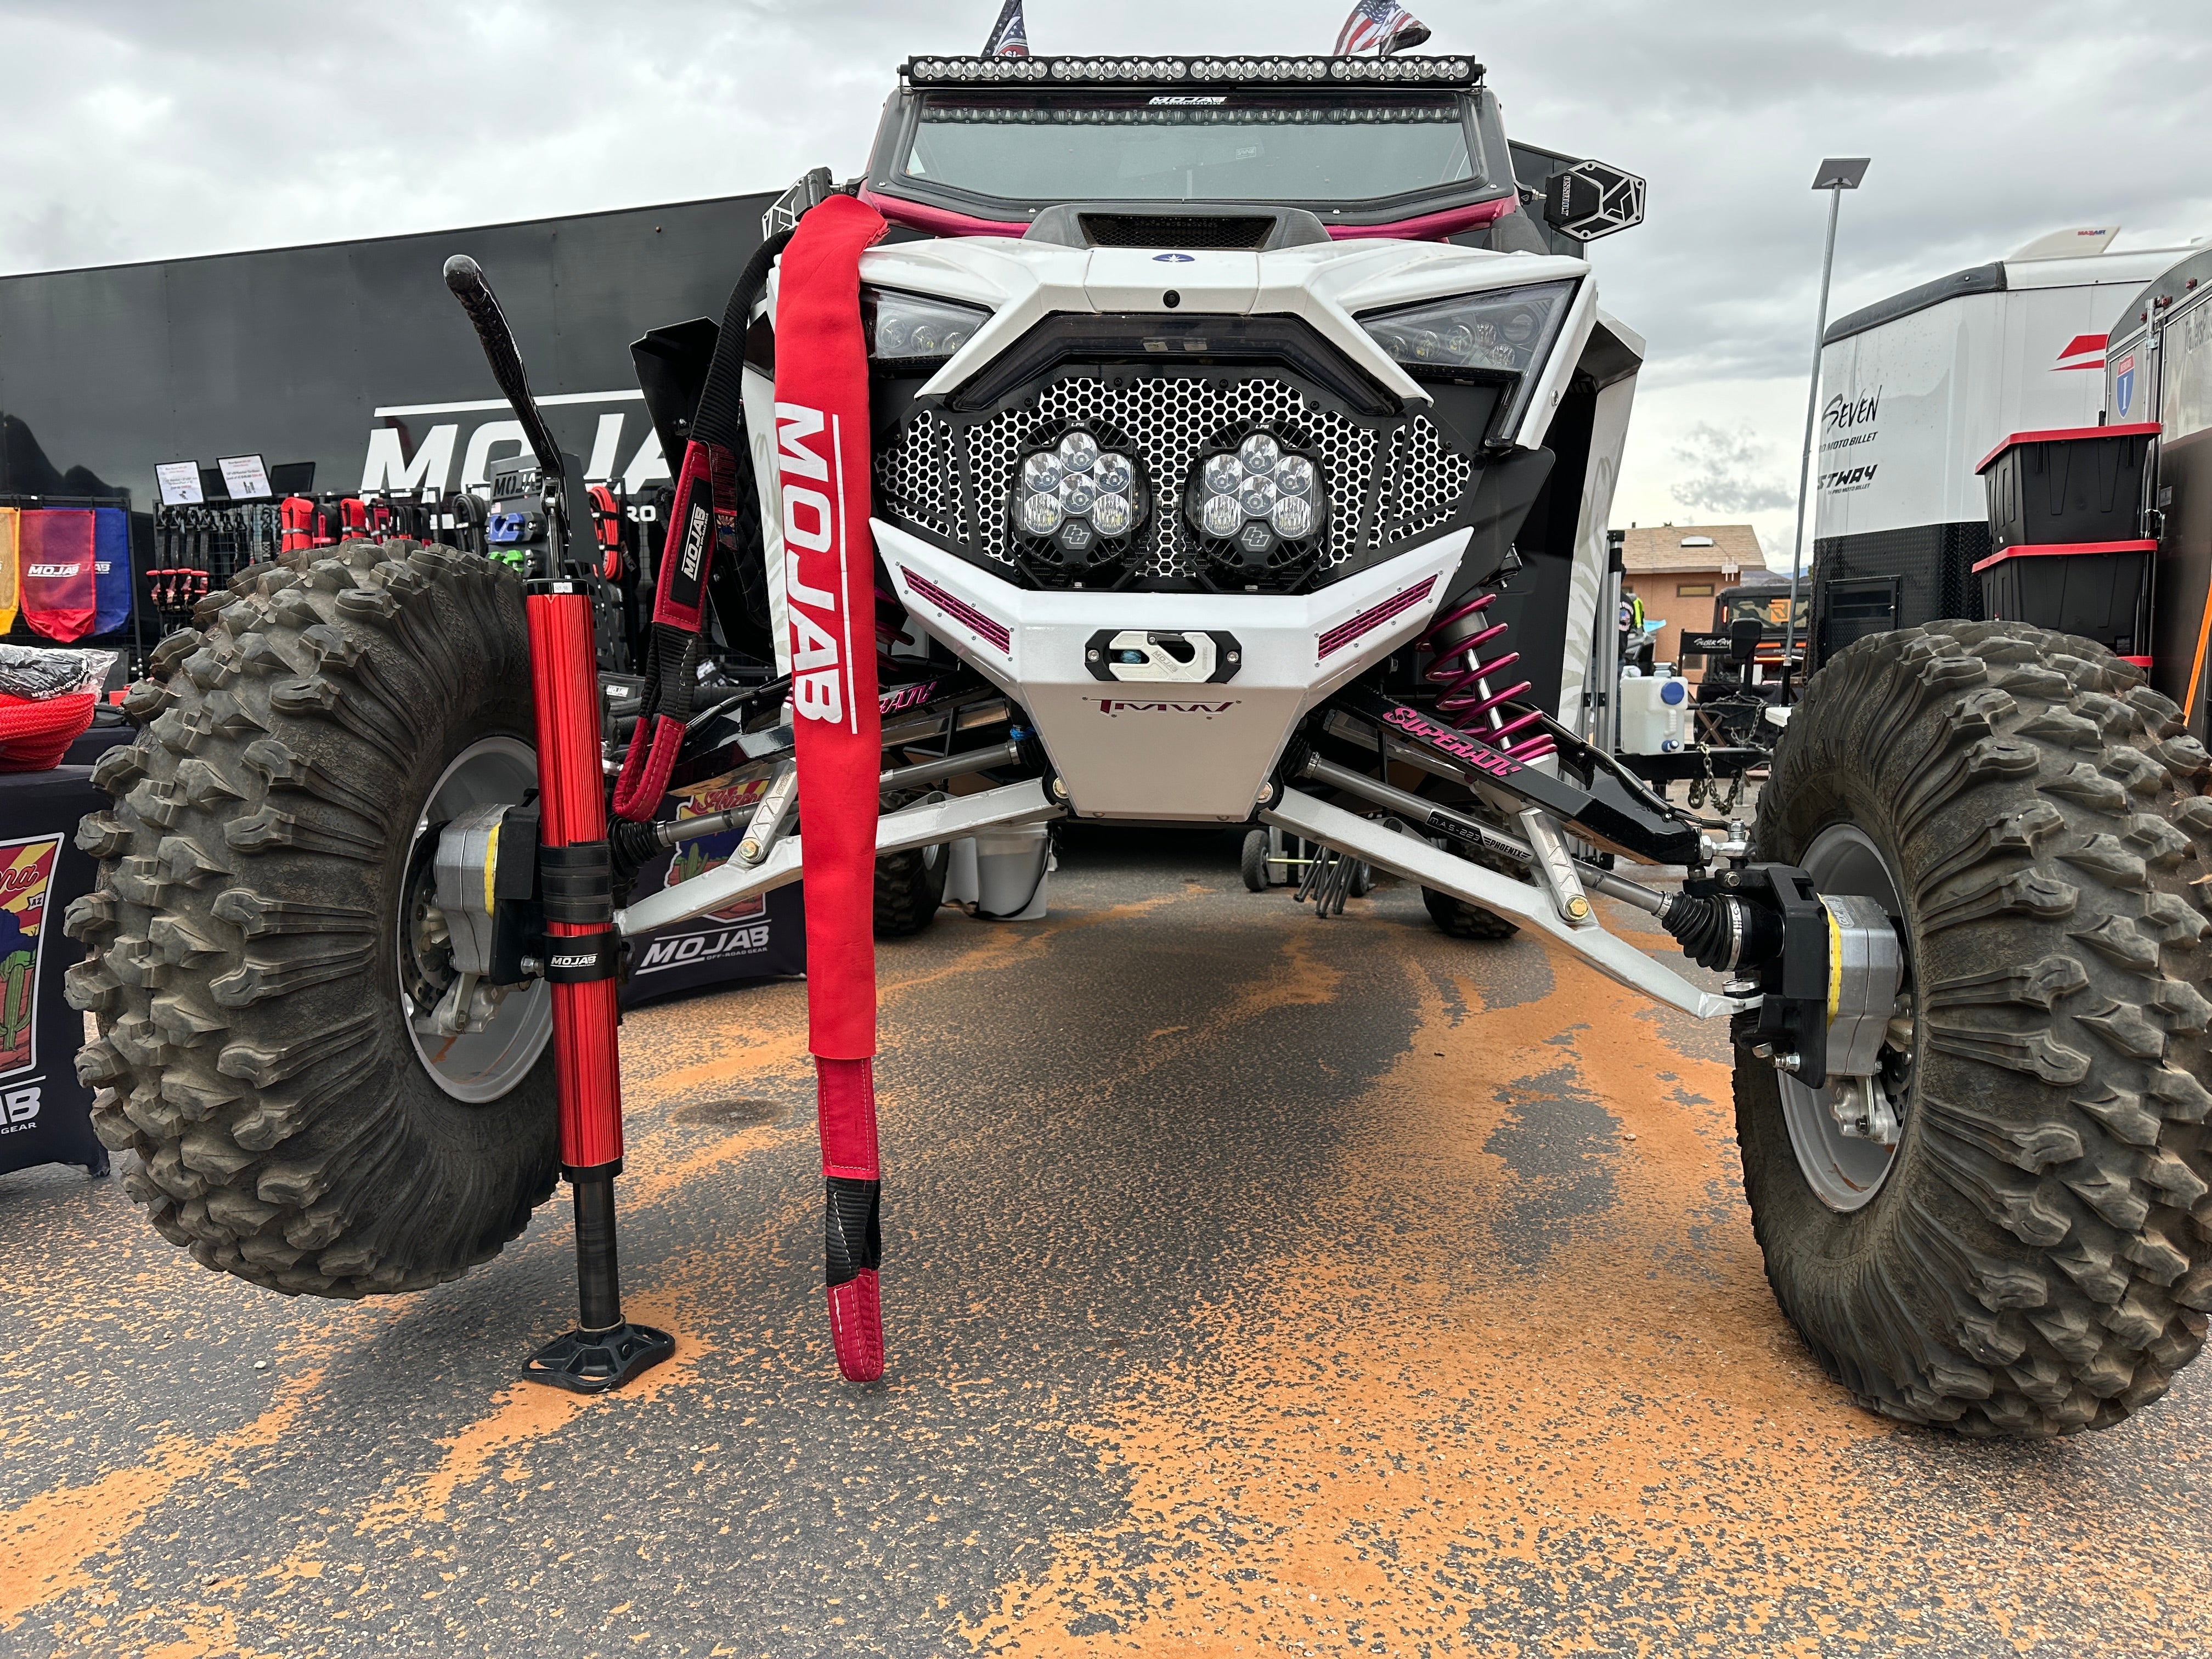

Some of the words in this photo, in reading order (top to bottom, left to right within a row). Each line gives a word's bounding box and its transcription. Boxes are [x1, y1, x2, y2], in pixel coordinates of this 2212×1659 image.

[1827, 438, 1849, 451] MOTO
[1849, 431, 1878, 446] BILLET
[684, 506, 706, 579] MOJAB
[29, 566, 80, 575] MOJAB
[774, 402, 843, 724] MOJAB
[1489, 839, 1523, 857] PHOENIX
[31, 897, 42, 906] AZ
[640, 925, 769, 968] MOJAB
[551, 956, 597, 965] MOJAB
[706, 950, 747, 961] OFF-ROAD
[1, 1122, 37, 1135] GEAR
